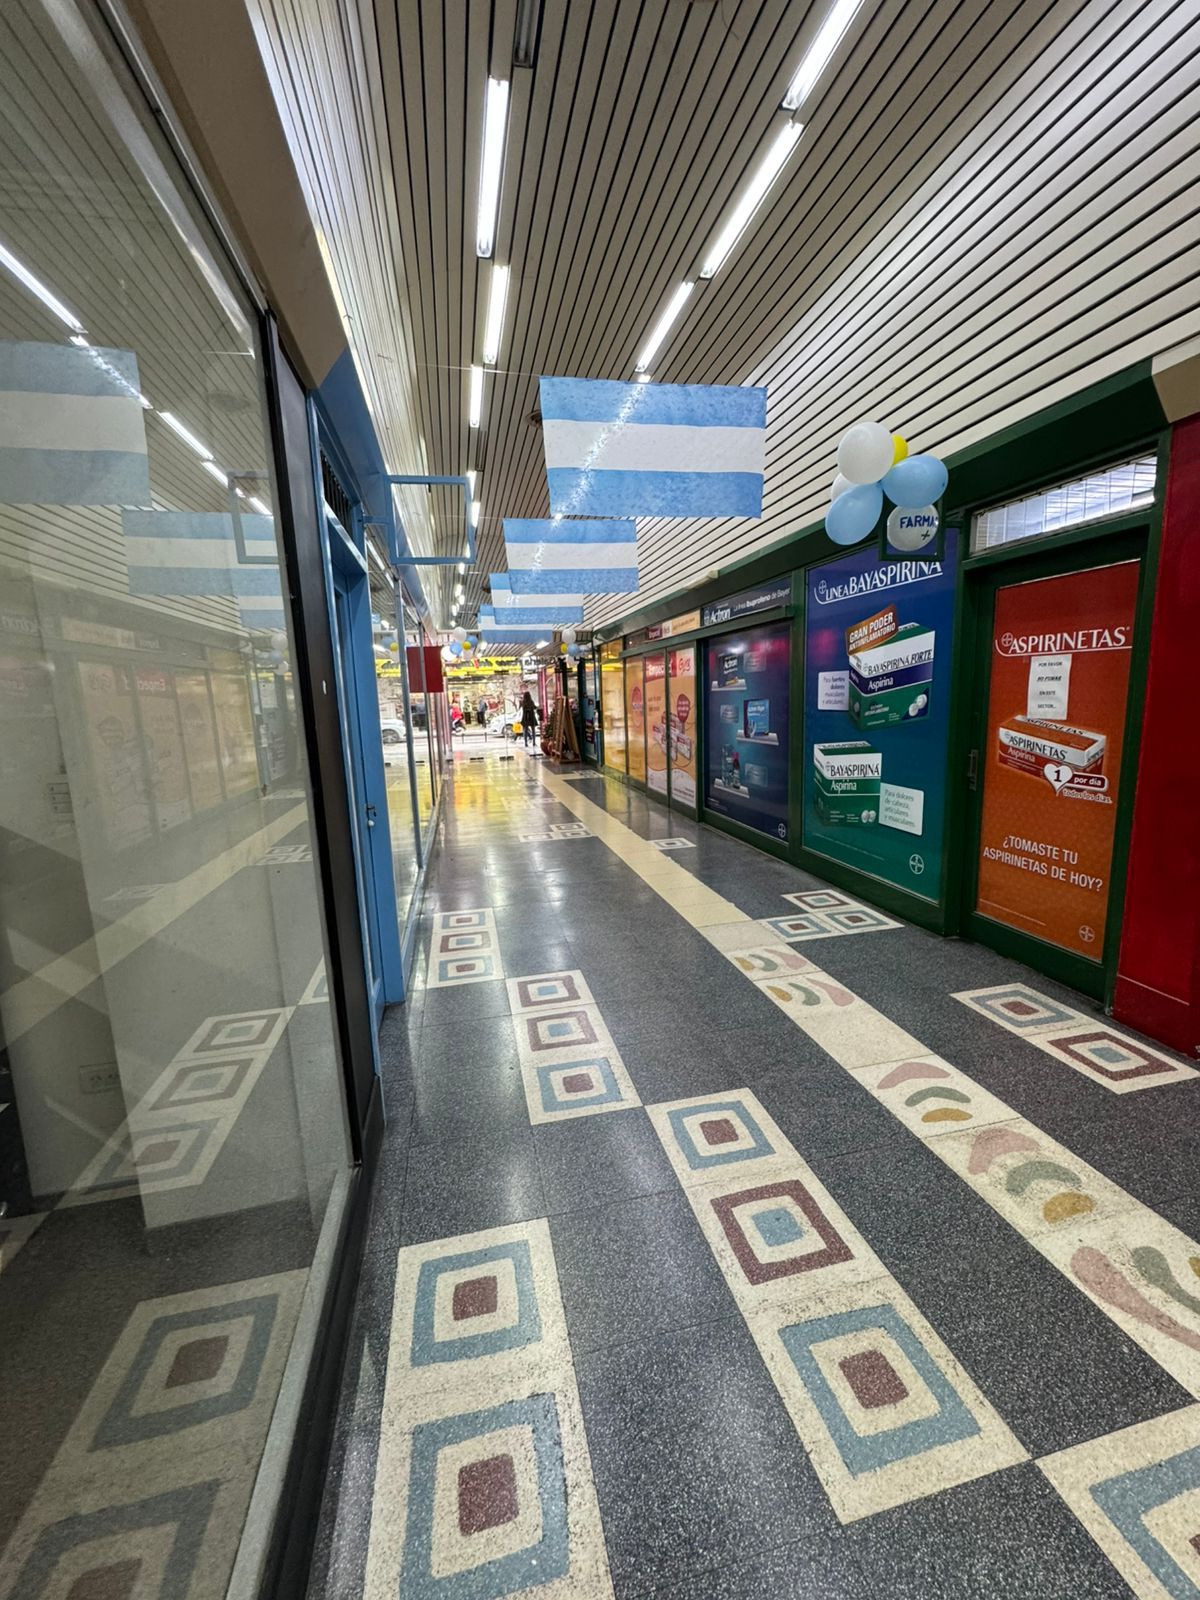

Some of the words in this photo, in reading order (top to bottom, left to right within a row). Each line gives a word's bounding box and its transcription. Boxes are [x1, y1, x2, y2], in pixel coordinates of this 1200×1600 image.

[849, 561, 942, 595] BAYASPIRINA
[709, 608, 731, 623] Actron
[849, 625, 868, 643] GRAN
[869, 611, 894, 633] PODER
[1008, 626, 1127, 654] ASPIRINETAS
[867, 656, 910, 675] BAYASPIRINA
[910, 648, 933, 664] FORTE
[868, 676, 894, 691] Aspirina
[1007, 746, 1036, 763] Aspirina
[1008, 735, 1065, 760] ASPIRINETAS
[830, 763, 880, 778] BAYASPIRINA
[1053, 769, 1062, 783] 1
[1073, 776, 1087, 785] por
[830, 780, 857, 795] Aspirina
[1002, 835, 1060, 860] ¿TOMASTE
[1062, 848, 1078, 865] TU
[983, 847, 1048, 876] ASPIRINETAS
[1051, 865, 1066, 882] DE
[1070, 869, 1103, 892] HOY?
